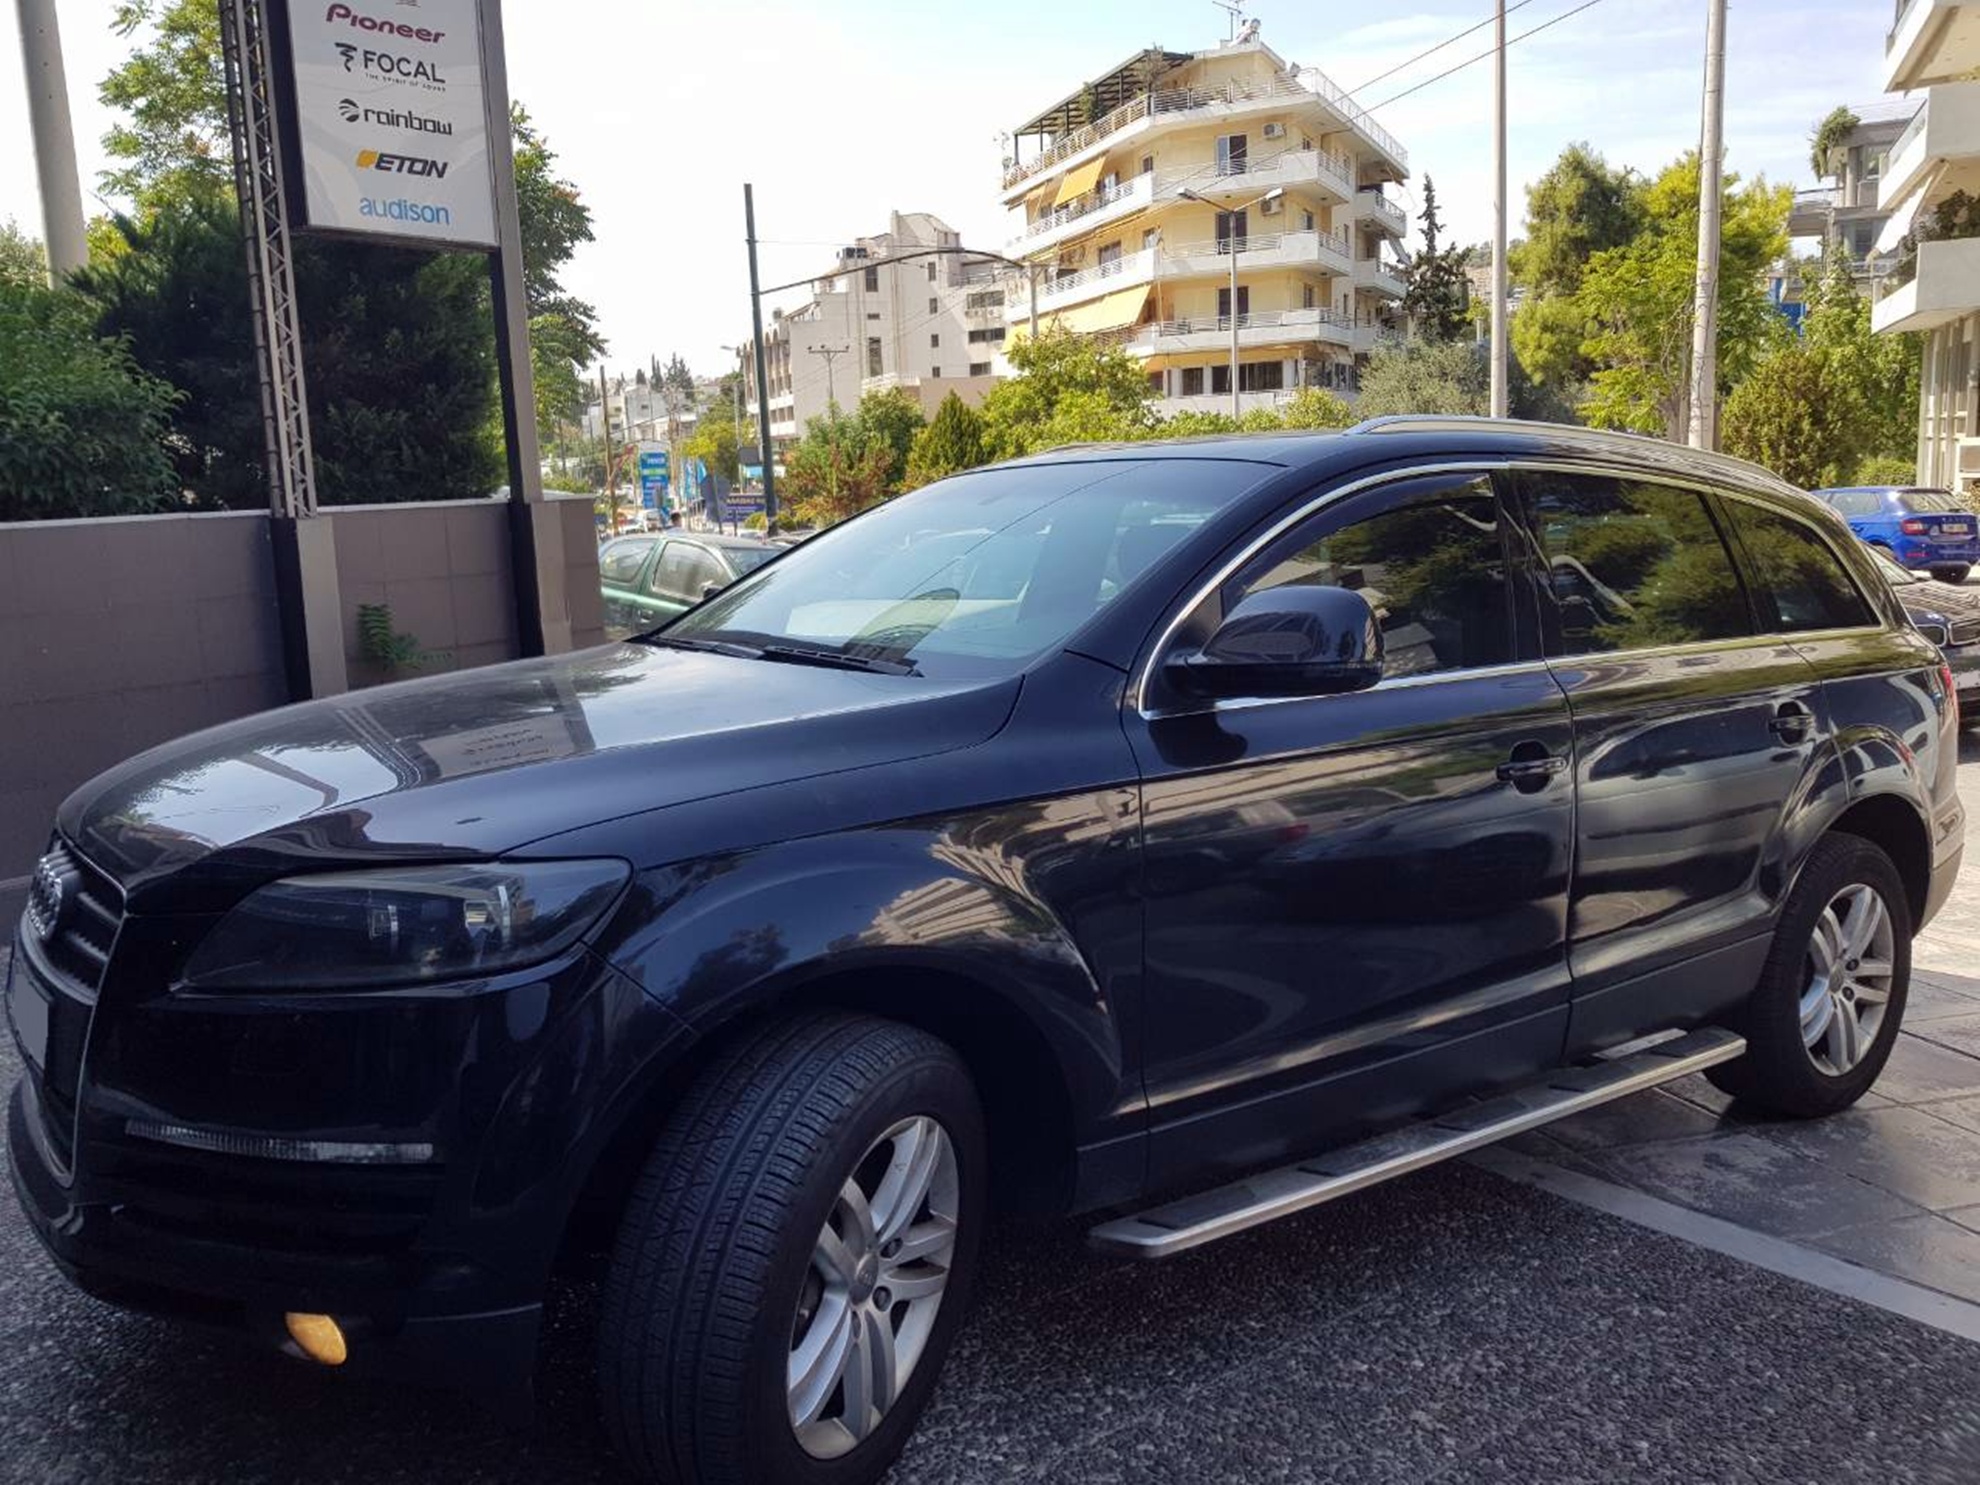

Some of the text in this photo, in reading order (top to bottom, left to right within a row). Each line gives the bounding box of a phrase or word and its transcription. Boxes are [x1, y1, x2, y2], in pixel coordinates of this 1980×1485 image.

[327, 4, 446, 43] Pioneer
[363, 49, 446, 83] FOCAL
[365, 72, 379, 81] THE
[382, 76, 407, 85] SPIRIT
[364, 107, 453, 136] rainbow
[375, 153, 448, 179] ETON
[360, 197, 450, 225] audison
